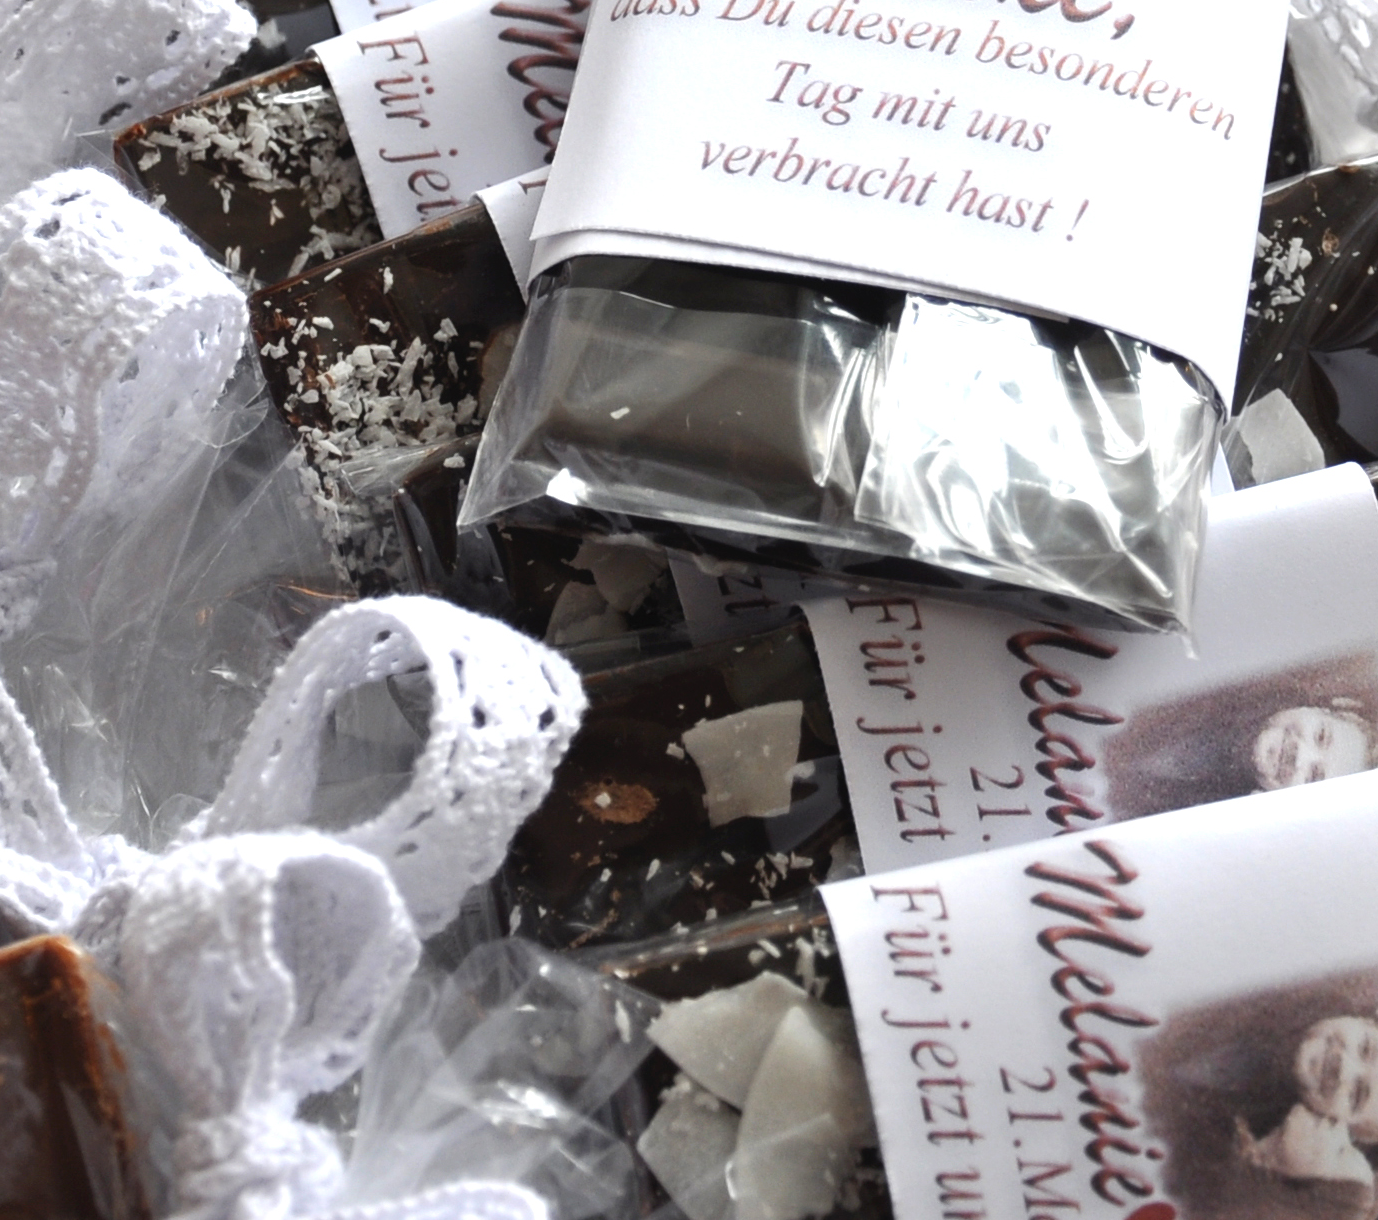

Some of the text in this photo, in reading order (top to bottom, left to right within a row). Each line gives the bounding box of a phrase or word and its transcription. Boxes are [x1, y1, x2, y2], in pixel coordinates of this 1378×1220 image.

[358, 32, 433, 128] Für
[766, 60, 1053, 153] Tag mit uns
[975, 20, 1237, 141] besonderen
[699, 135, 936, 207] verbracht
[946, 186, 1055, 233] hast
[845, 595, 954, 843] Für jetzt
[870, 883, 951, 993] Für
[881, 1008, 982, 1146] jetzt
[1023, 839, 1163, 1205] Melanie
[999, 1066, 1080, 1220] 21.M
